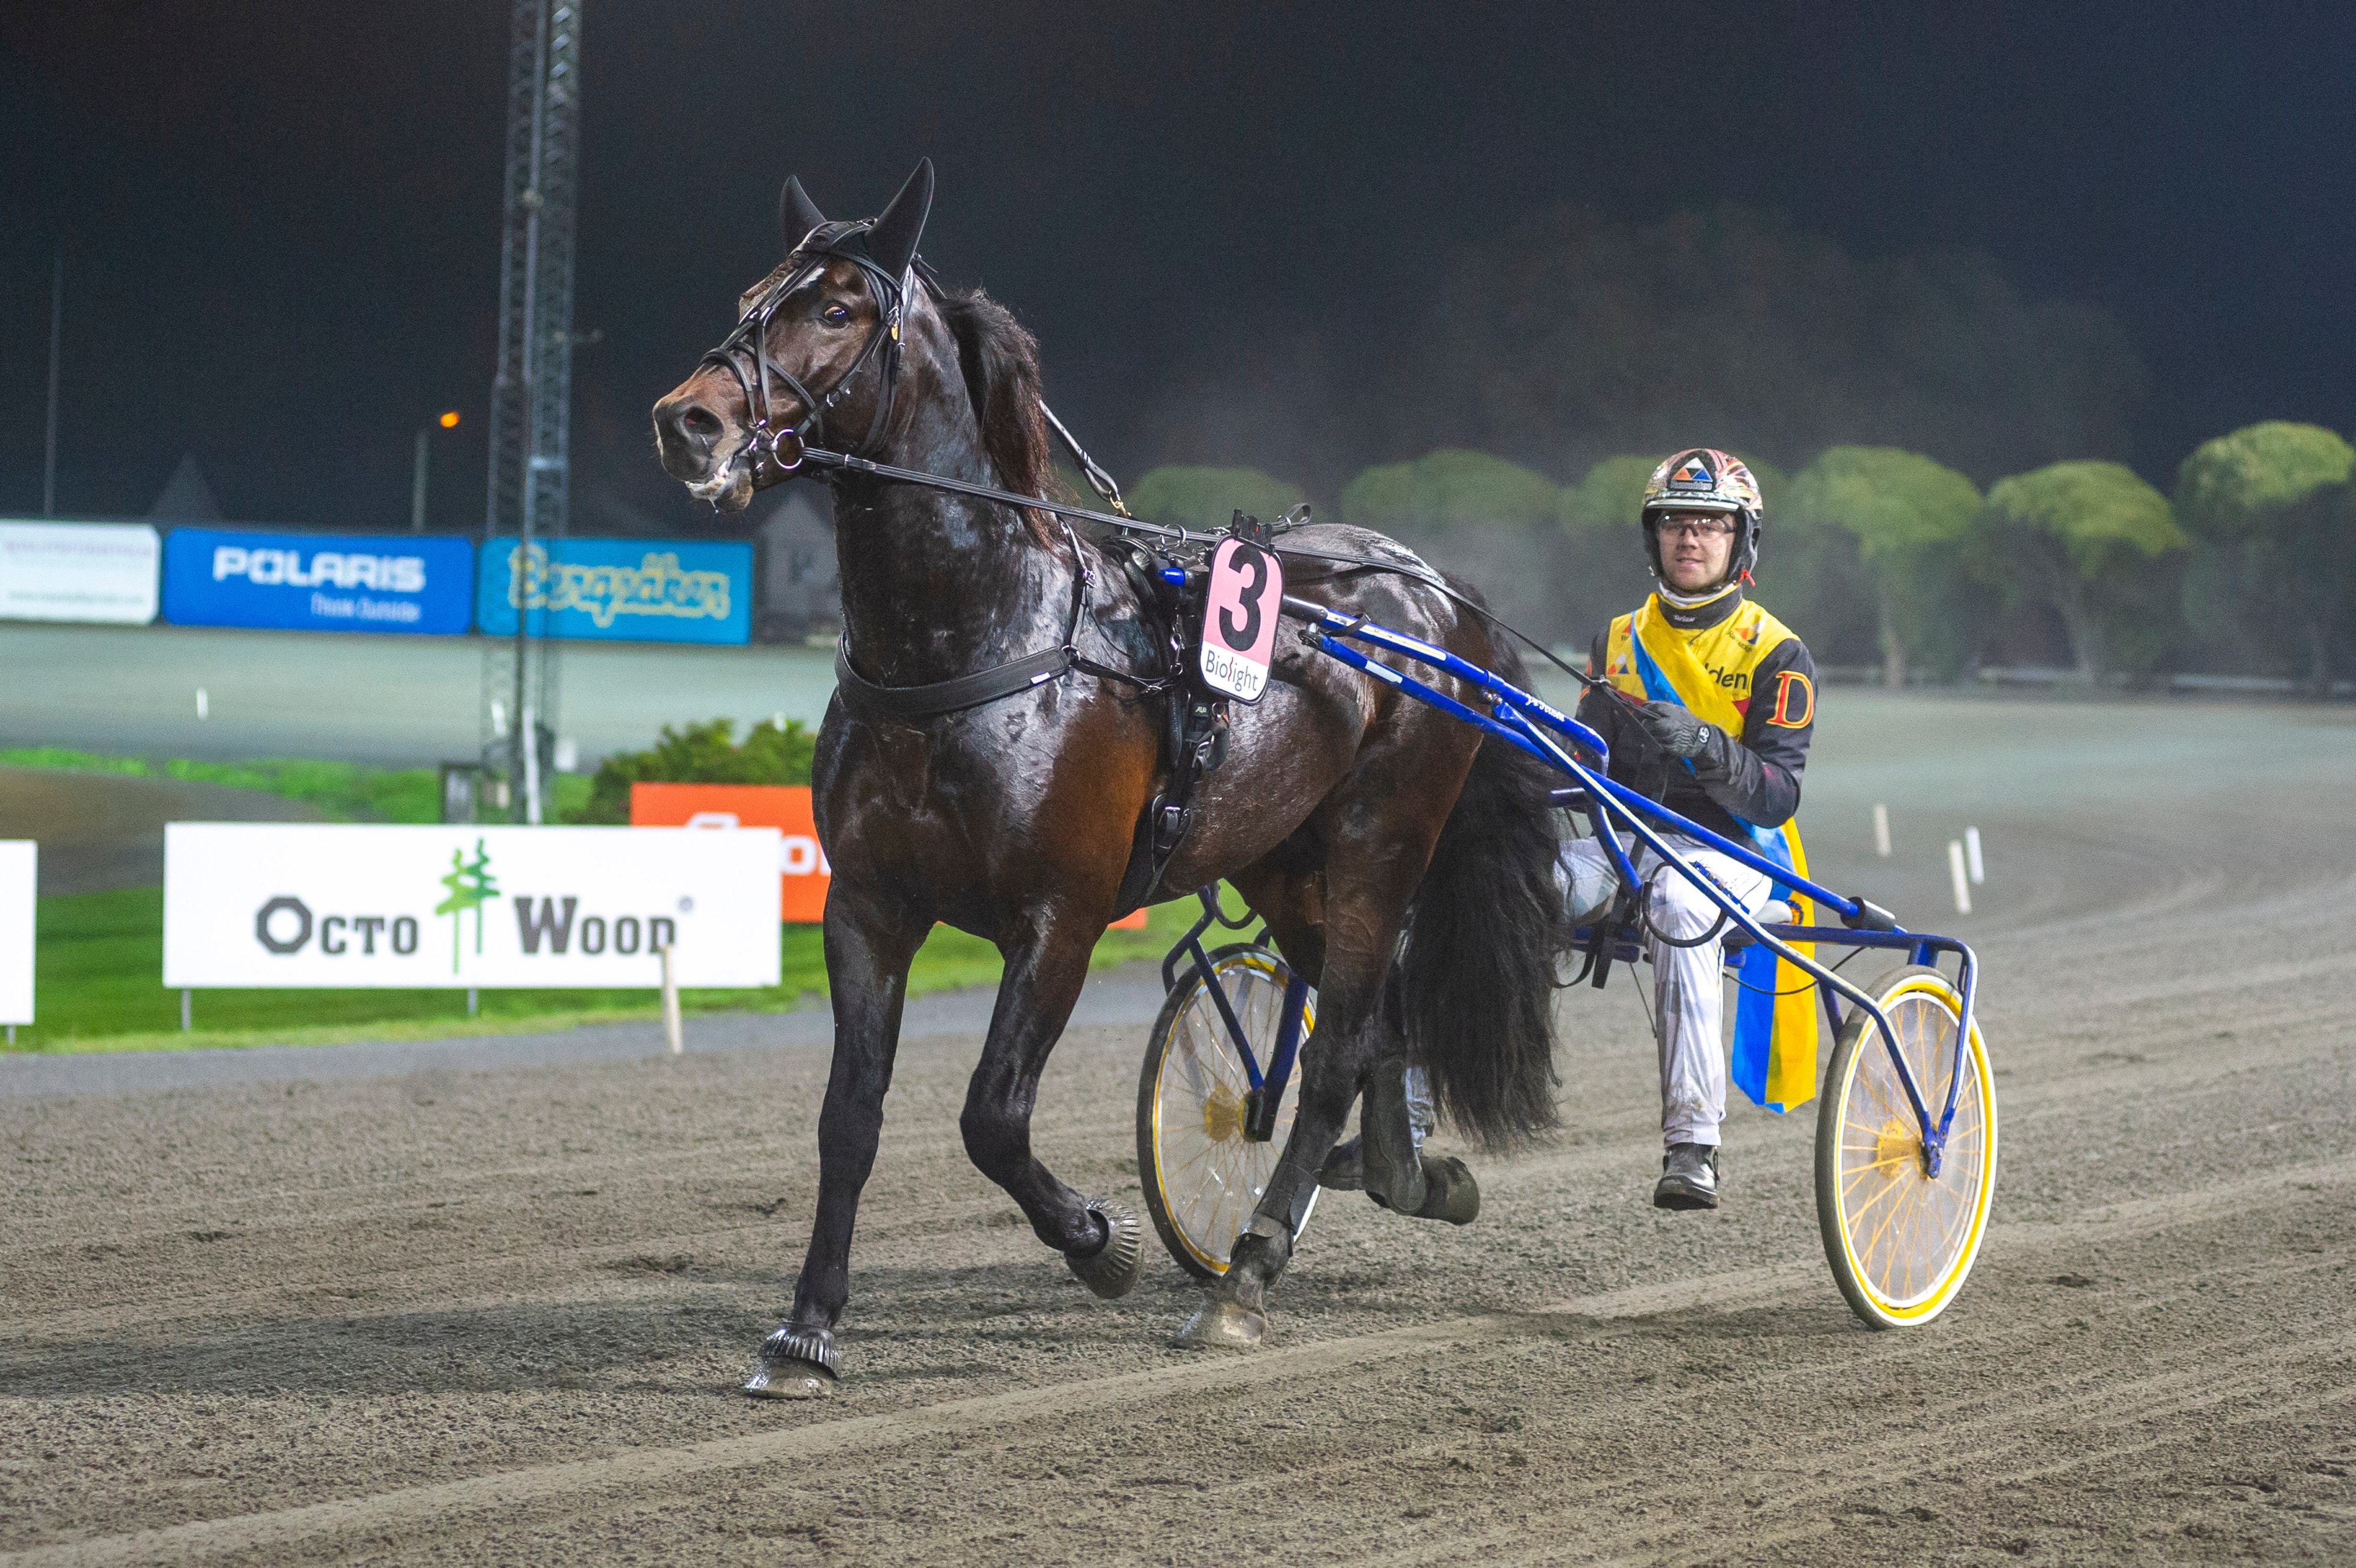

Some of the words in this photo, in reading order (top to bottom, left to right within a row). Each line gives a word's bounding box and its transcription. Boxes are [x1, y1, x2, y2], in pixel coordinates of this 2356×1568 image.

[213, 546, 426, 593] POLARIS
[1219, 543, 1268, 651] 3
[1206, 650, 1258, 692] Biolight
[1766, 670, 1814, 729] D
[256, 896, 418, 955] OCTO
